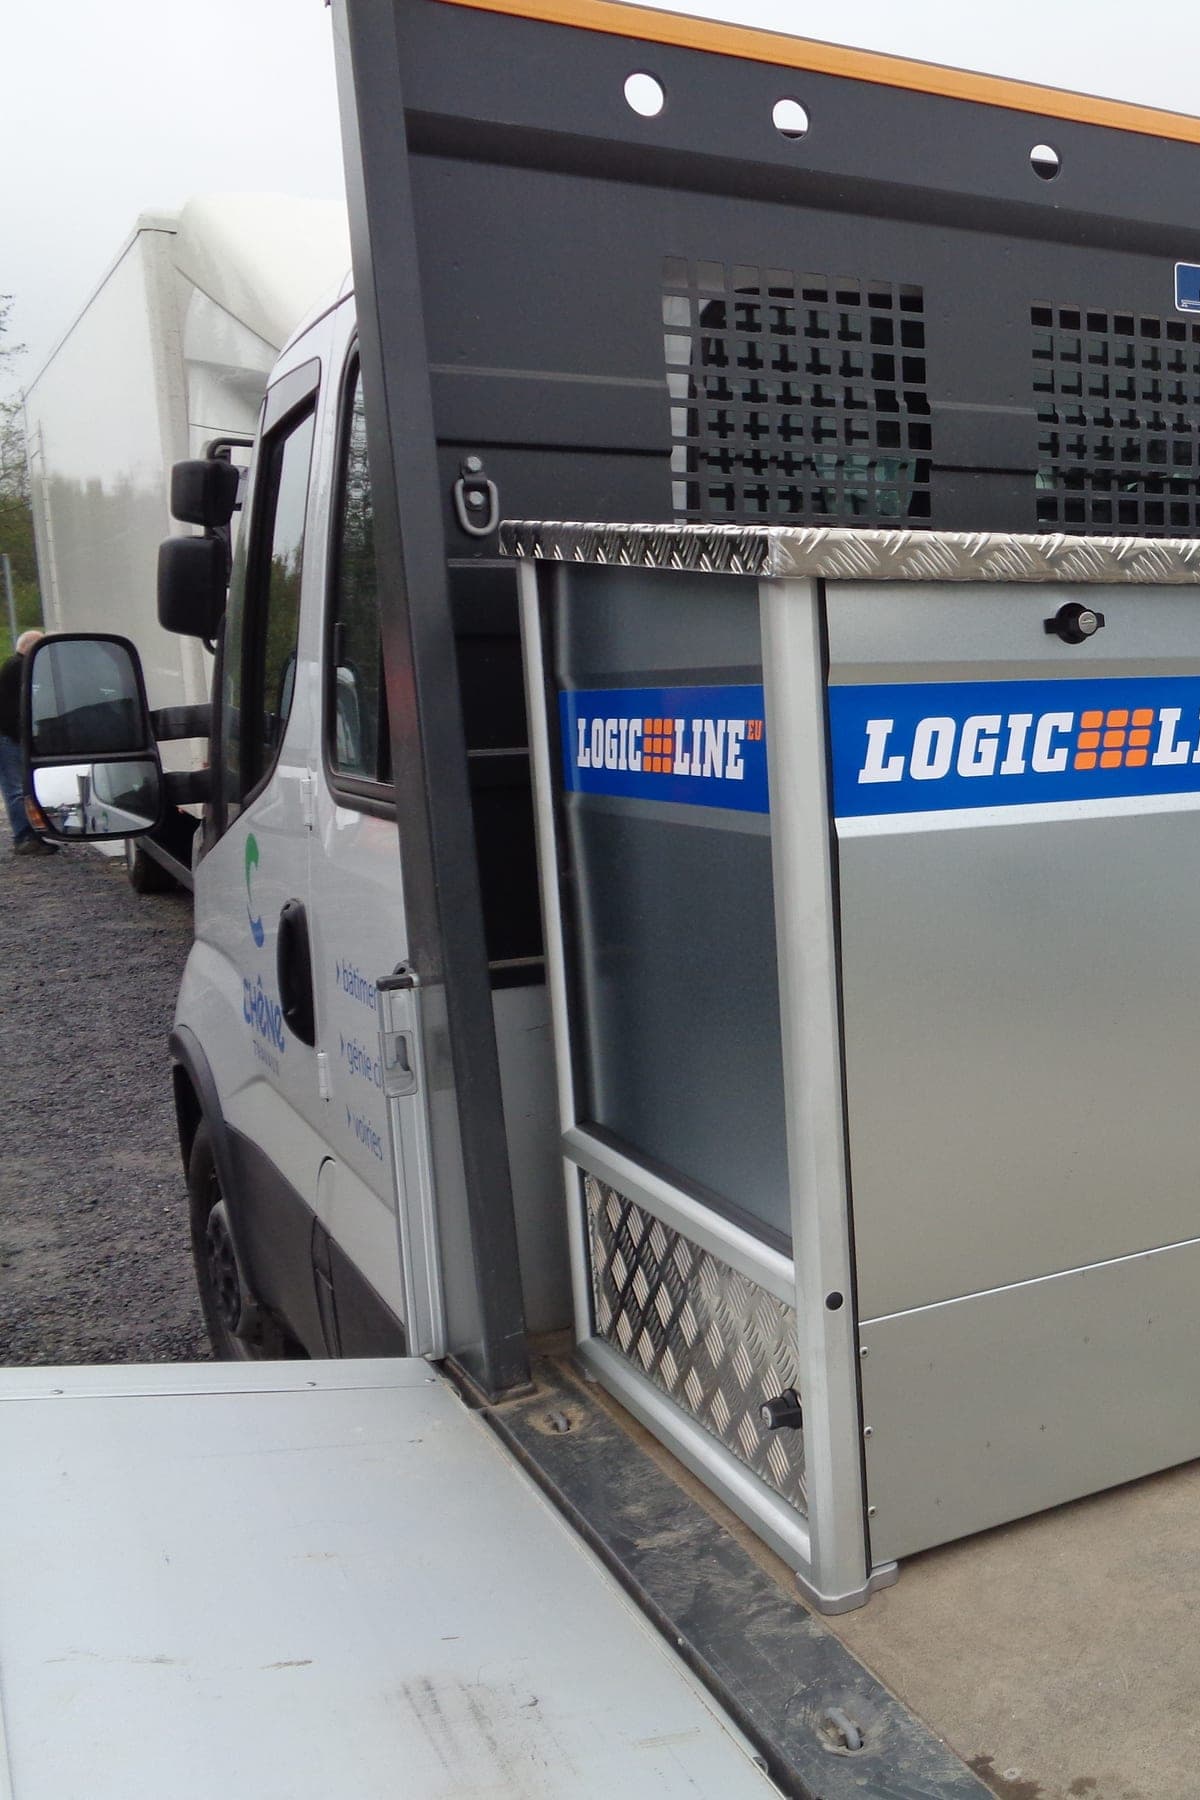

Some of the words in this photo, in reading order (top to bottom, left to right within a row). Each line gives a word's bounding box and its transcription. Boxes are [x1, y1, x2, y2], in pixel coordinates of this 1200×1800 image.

[577, 718, 642, 772] LOGIC
[673, 719, 745, 780] LINE
[858, 711, 1074, 784] LOGIC
